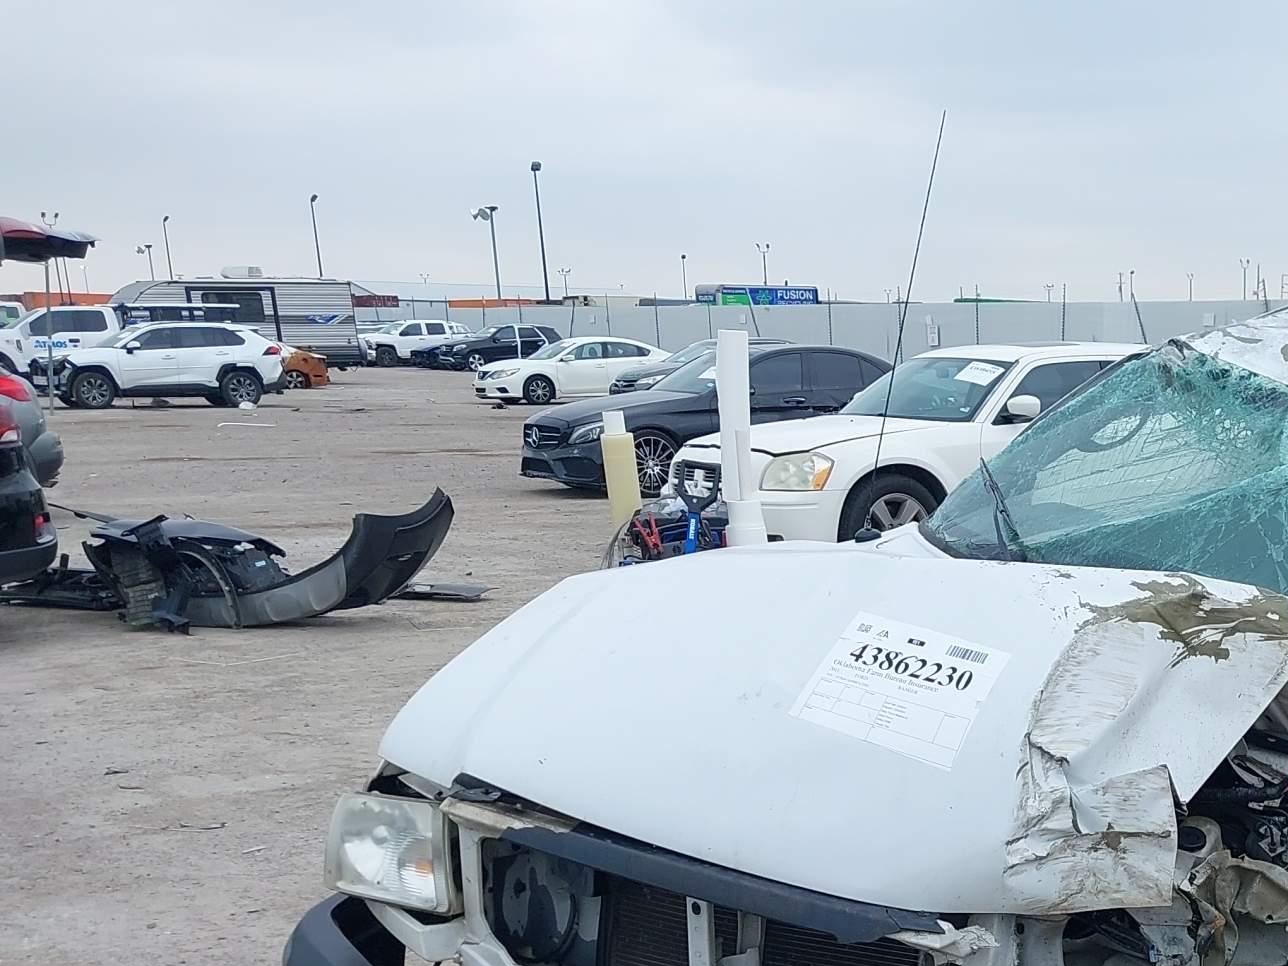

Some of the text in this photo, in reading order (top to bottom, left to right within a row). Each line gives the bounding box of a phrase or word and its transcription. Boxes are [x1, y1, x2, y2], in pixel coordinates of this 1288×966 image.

[777, 290, 813, 300] FUSION
[833, 659, 866, 672] Oklahoma
[866, 668, 884, 678] Farm
[884, 672, 907, 684] Bureau
[907, 680, 939, 692] Insurance
[849, 644, 973, 691] 43862230
